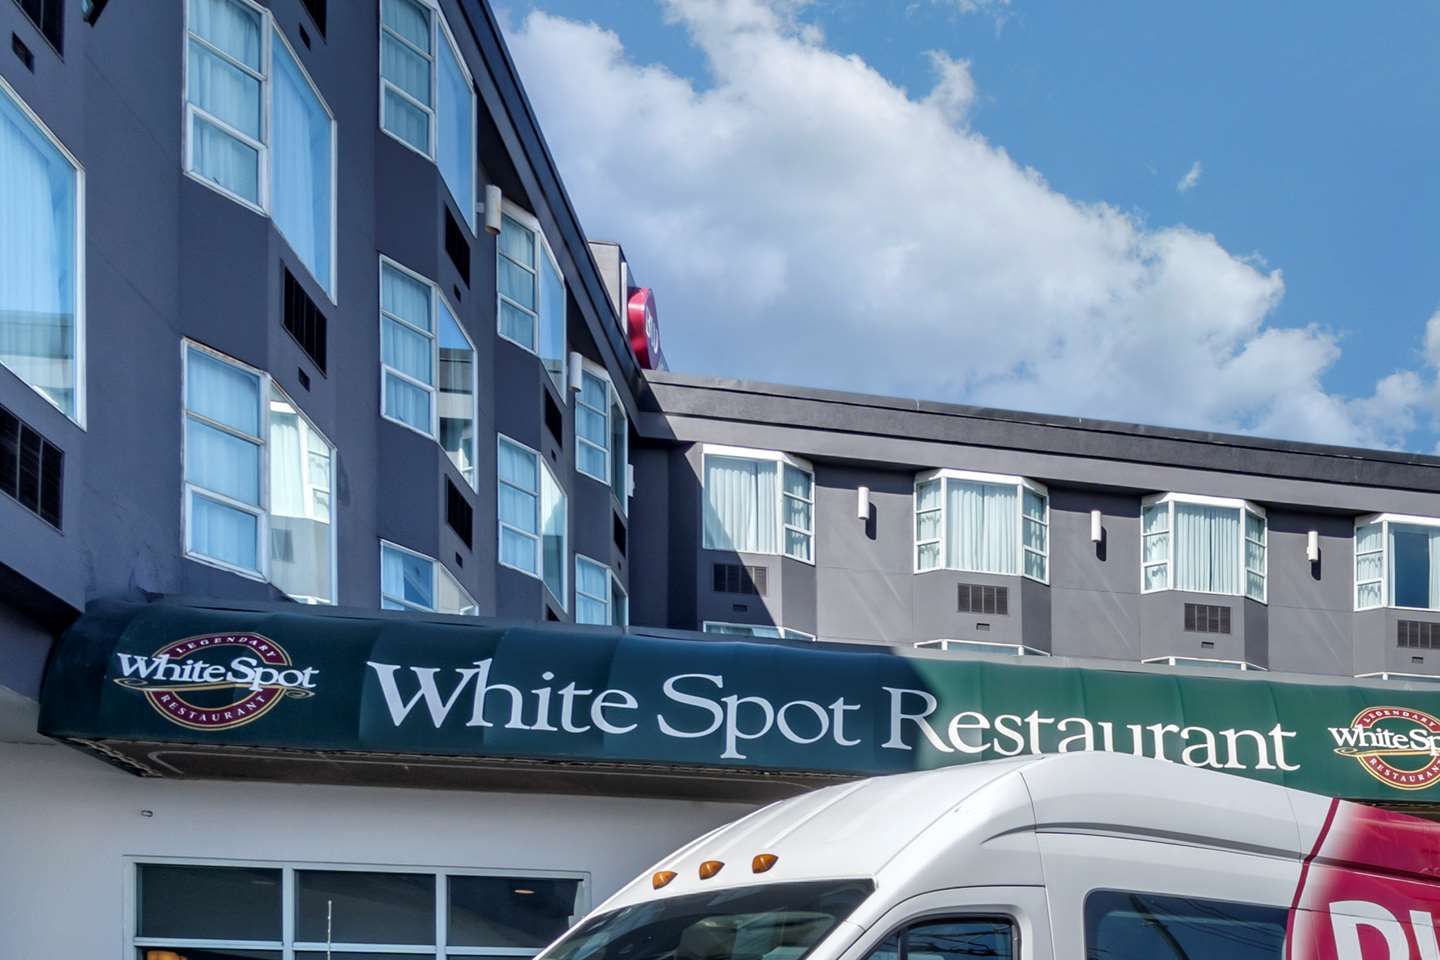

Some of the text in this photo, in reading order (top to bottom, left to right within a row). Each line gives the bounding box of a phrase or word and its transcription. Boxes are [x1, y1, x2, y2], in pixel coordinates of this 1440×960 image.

[176, 636, 278, 658] LEGENDARY
[161, 693, 266, 721] RESTAURANT
[366, 658, 1301, 771] White Spot Restaurant
[1363, 709, 1437, 728] LEGENDARY
